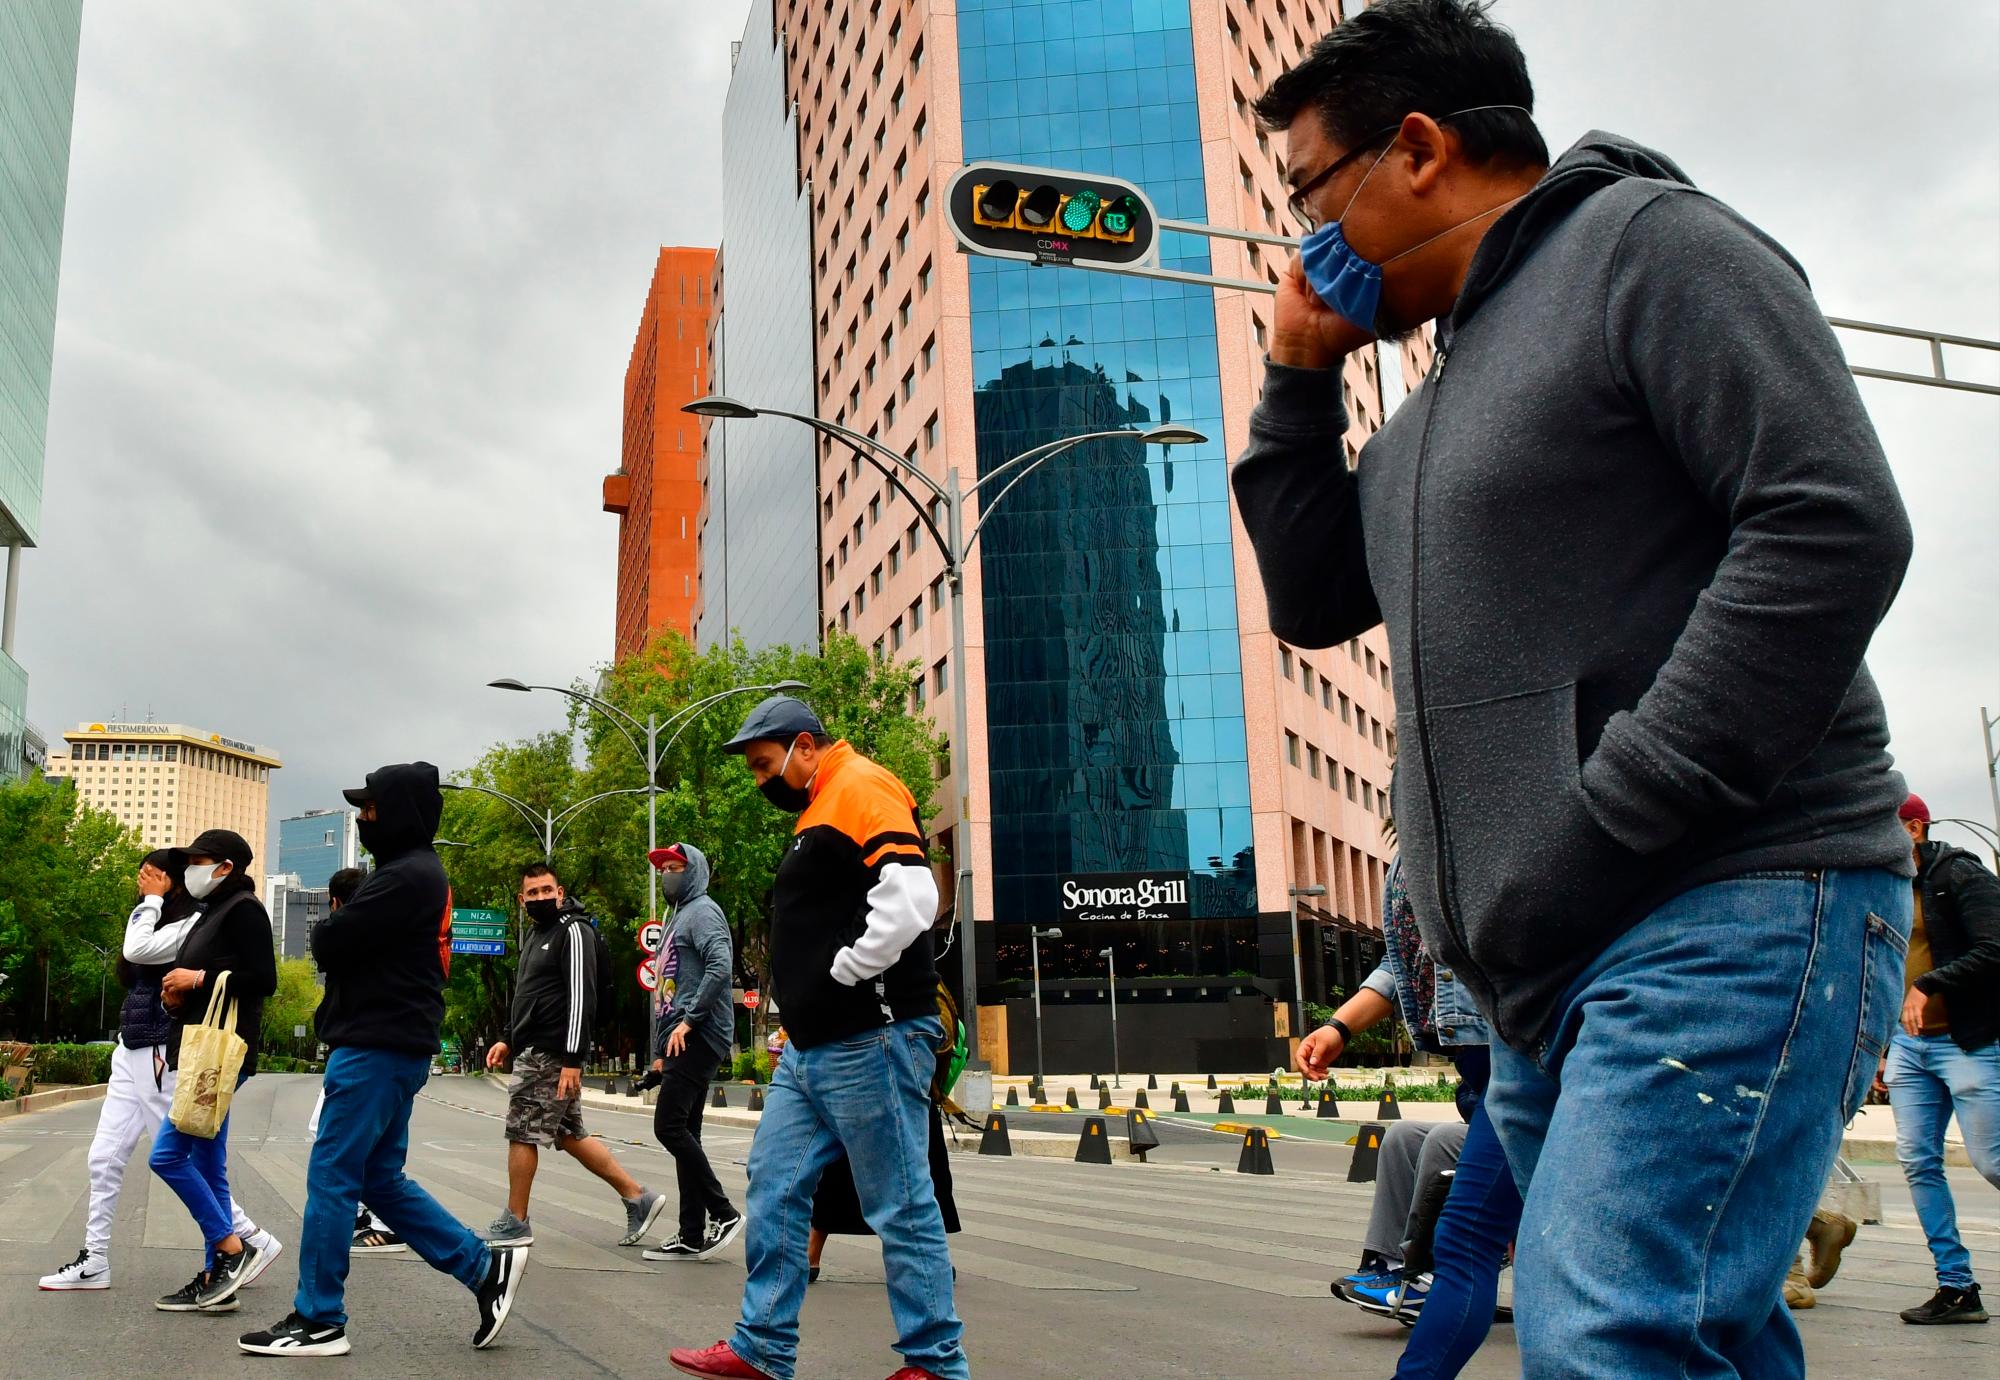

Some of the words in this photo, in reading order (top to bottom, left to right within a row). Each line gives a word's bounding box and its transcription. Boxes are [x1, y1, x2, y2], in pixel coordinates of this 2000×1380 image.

[1037, 240, 1068, 250] CDMX
[1063, 881, 1136, 910] Sonora
[470, 912, 492, 920] NIZA
[1079, 912, 1115, 920] Cocina
[1120, 911, 1132, 919] de
[1138, 909, 1169, 919] Brasa
